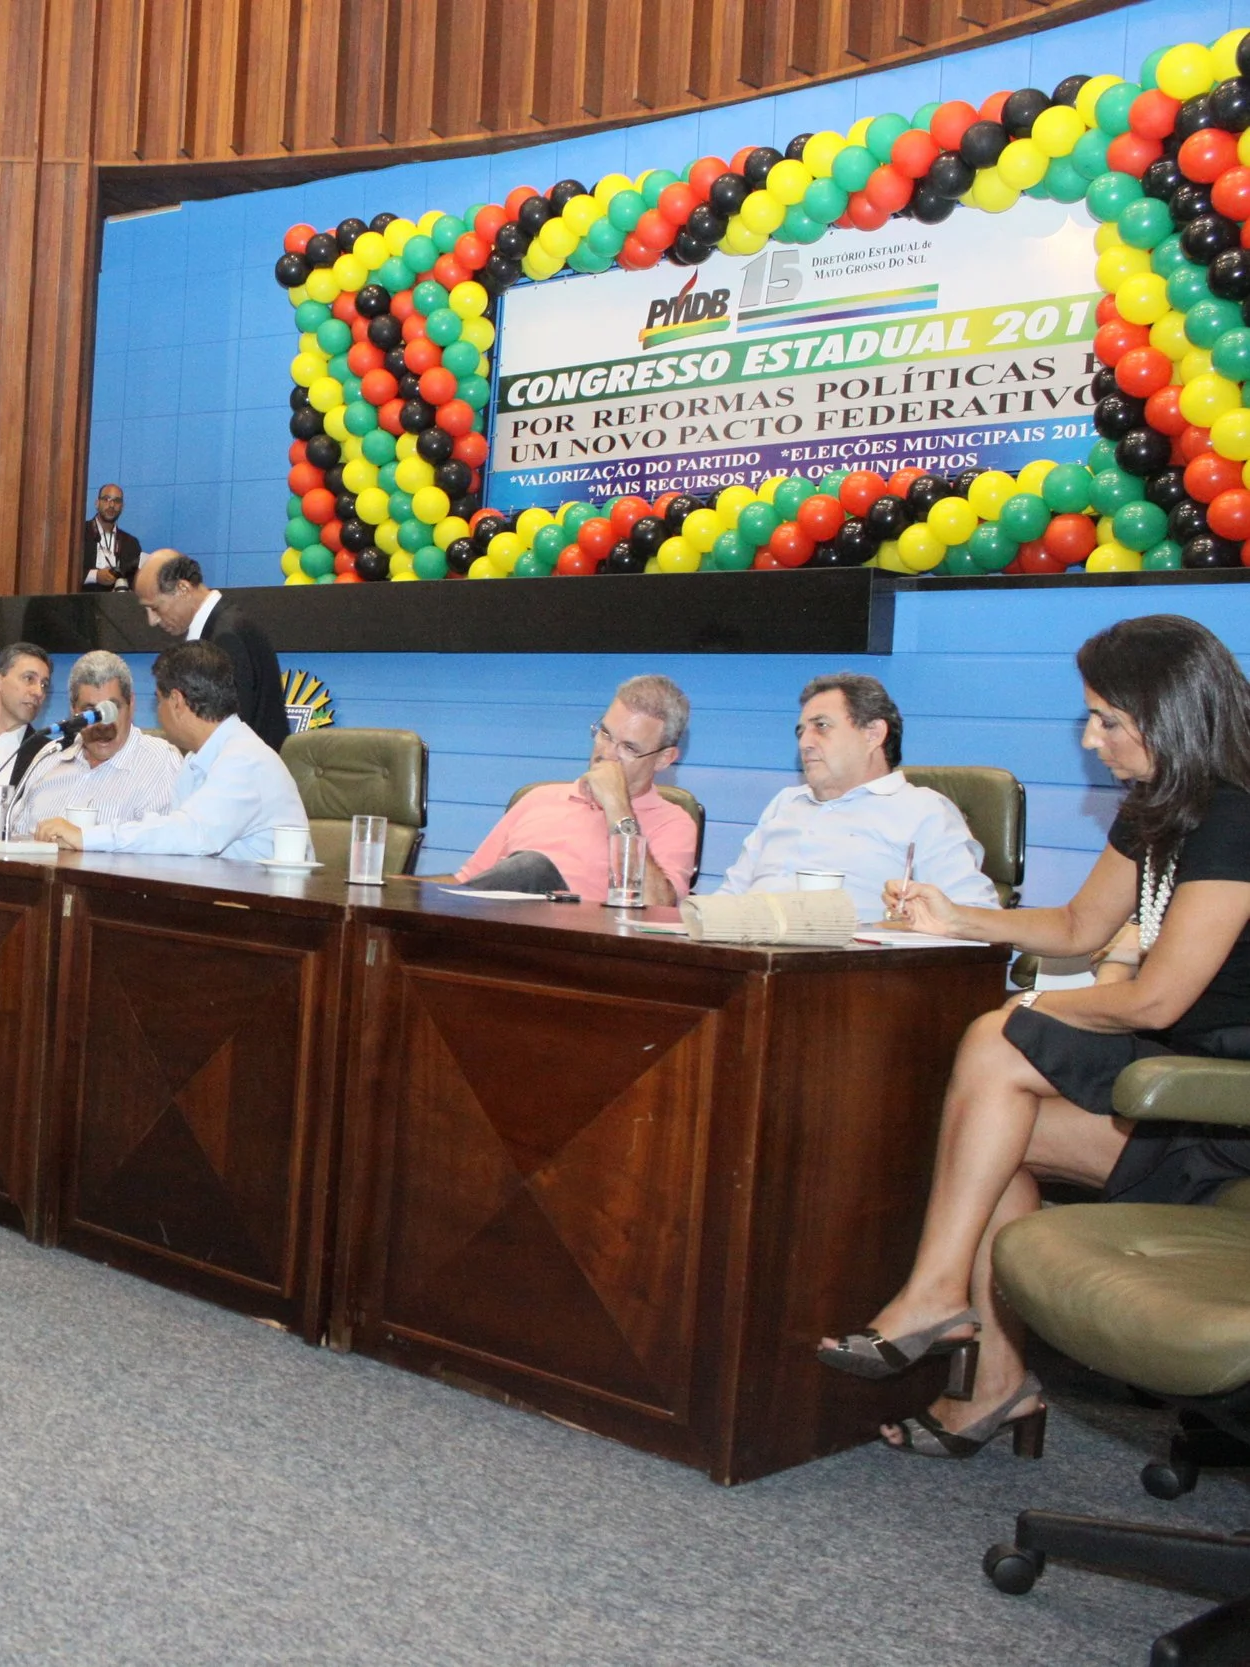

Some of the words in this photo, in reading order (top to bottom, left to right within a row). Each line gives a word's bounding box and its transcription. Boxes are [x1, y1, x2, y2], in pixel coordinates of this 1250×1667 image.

[812, 250, 866, 267] DIRETÓRIO
[869, 242, 920, 258] ESTADUAL
[922, 240, 932, 249] de
[814, 268, 843, 280] MATO
[846, 260, 886, 276] GROSSO
[907, 255, 927, 266] SUL
[739, 249, 803, 308] 15
[646, 288, 731, 330] PMDB
[507, 350, 731, 407] CONGRESSO
[742, 318, 971, 376] ESTADUAL
[987, 301, 1091, 346] 201
[511, 414, 574, 438] POR
[593, 386, 795, 429] REFORMAS
[816, 356, 1056, 403] POLÍTICAS
[511, 441, 558, 463] UM
[570, 429, 667, 457] NOVO
[677, 414, 803, 446] PACTO
[814, 383, 1098, 432] FEDERATIVO
[903, 427, 1045, 451] MUNICIPAIS
[645, 472, 745, 492] RECURSOS
[750, 467, 801, 484] PARA
[807, 464, 834, 479] OS
[839, 452, 978, 474] MUNICIPIOS
[648, 460, 672, 475] DO
[676, 452, 761, 472] PARTIDO
